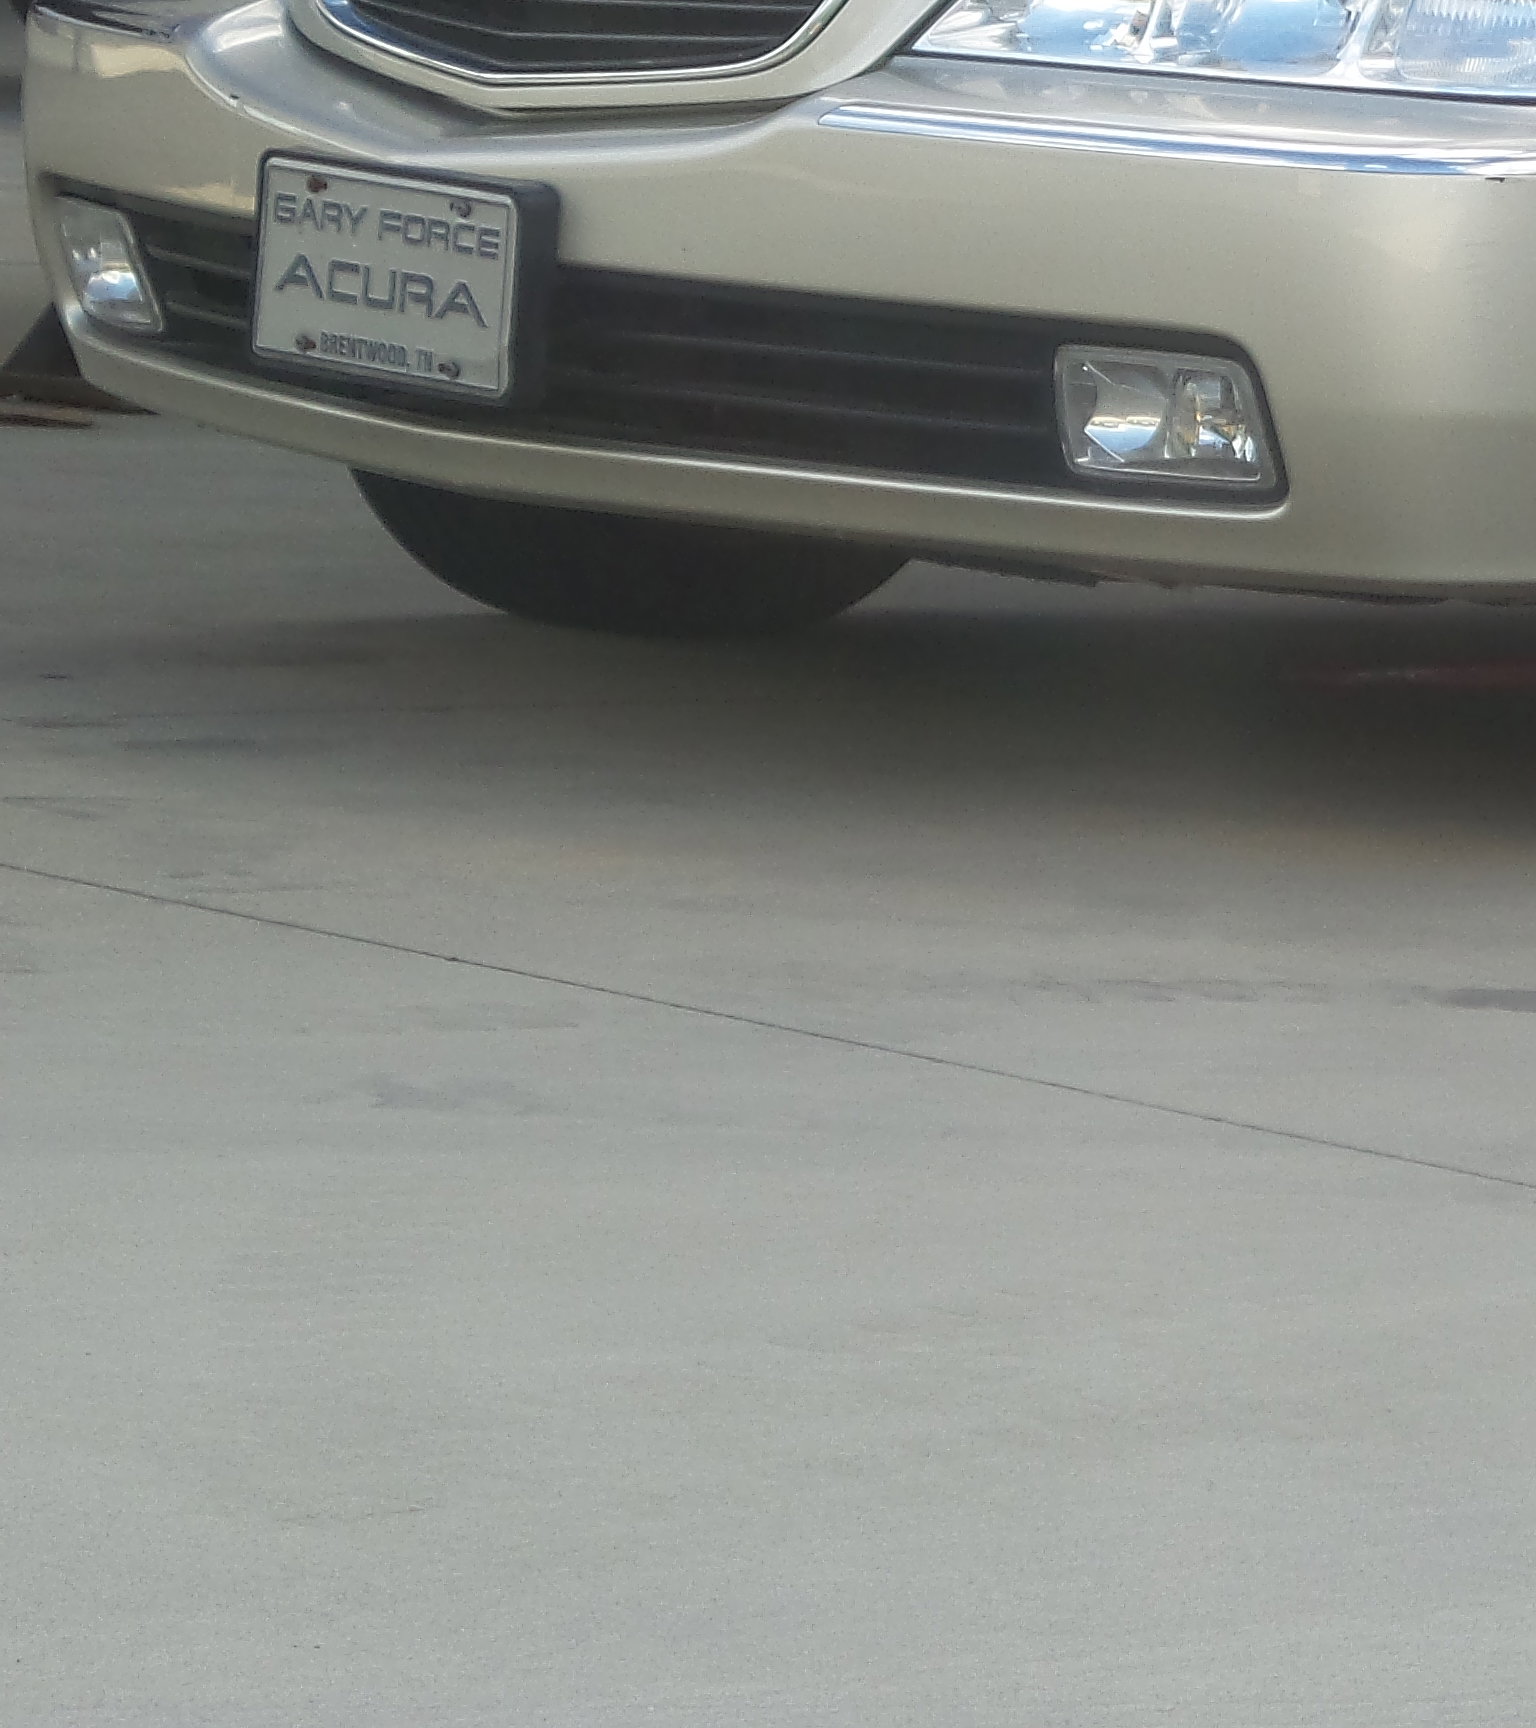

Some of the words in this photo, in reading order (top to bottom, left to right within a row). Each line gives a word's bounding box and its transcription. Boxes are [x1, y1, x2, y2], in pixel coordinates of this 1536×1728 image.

[273, 191, 368, 239] GARY
[377, 208, 500, 260] FORCE
[273, 252, 488, 329] ACURA
